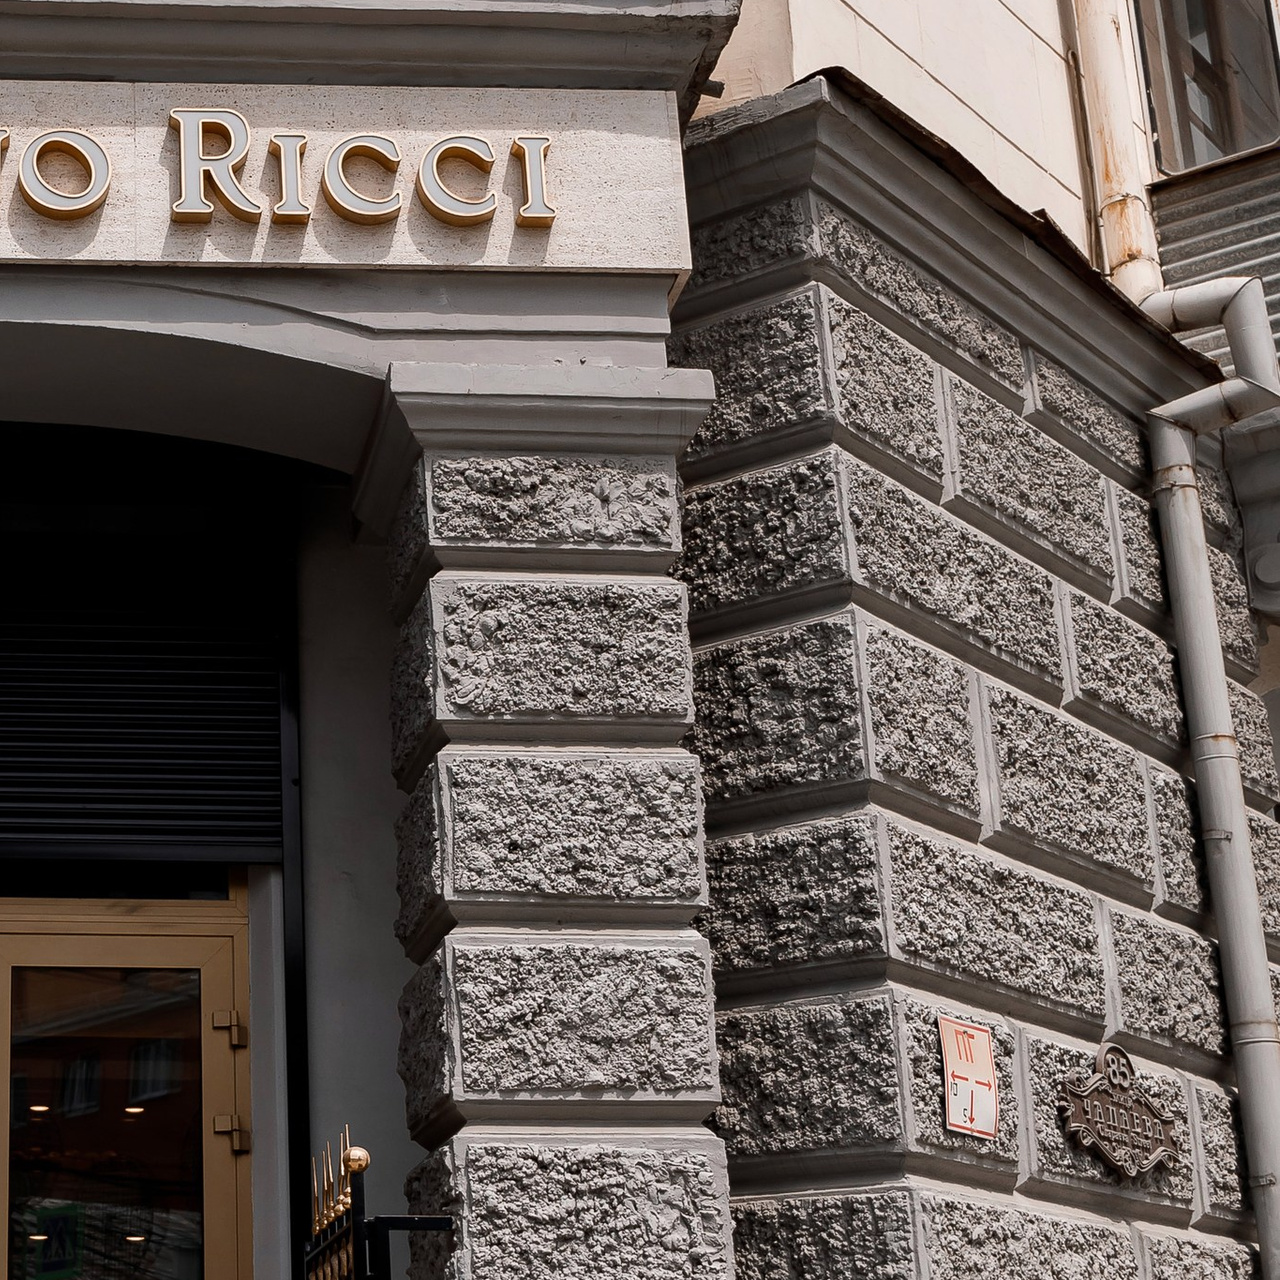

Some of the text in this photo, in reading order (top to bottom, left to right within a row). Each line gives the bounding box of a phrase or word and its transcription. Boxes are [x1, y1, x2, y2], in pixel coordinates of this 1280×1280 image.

[168, 107, 558, 229] RICCI
[1106, 1054, 1131, 1088] 85
[1082, 1098, 1165, 1140] ЧАПАЕВА
